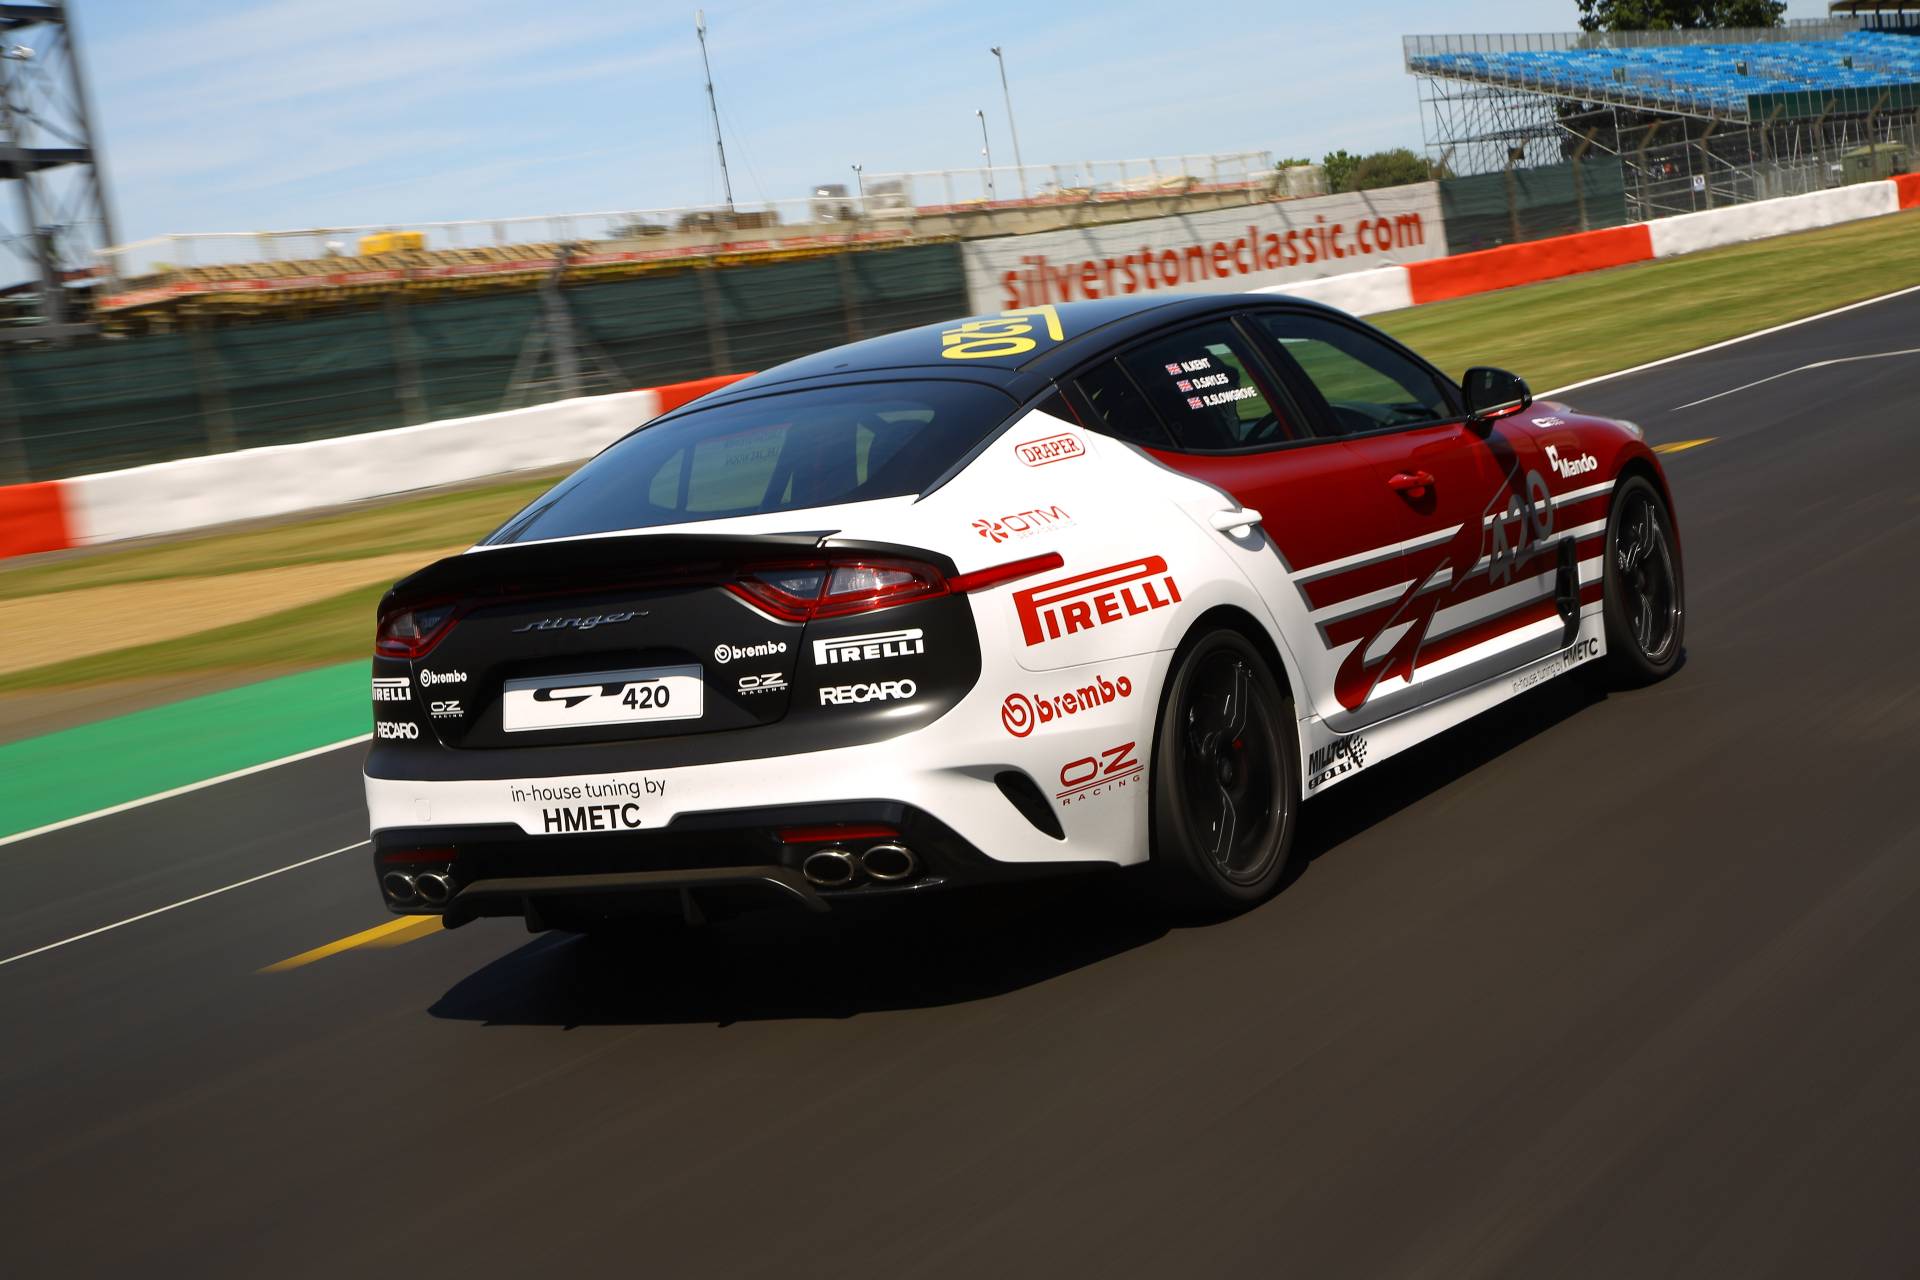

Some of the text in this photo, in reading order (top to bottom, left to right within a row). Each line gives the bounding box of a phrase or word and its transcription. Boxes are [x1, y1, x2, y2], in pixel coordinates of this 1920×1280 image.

[1003, 211, 1424, 310] silverstoneclassic.com
[1181, 358, 1211, 373] N.KENT
[1192, 373, 1229, 390] D.SAYLES
[1203, 386, 1258, 407] R.SLOWGROVE
[1021, 438, 1080, 463] DRAPER
[1558, 452, 1598, 478] Mando
[1000, 505, 1070, 532] OTM
[1489, 469, 1553, 586] 420
[1012, 555, 1182, 647] PIRELLI
[732, 640, 787, 660] brembo
[812, 628, 924, 665] PIRELLI
[1562, 638, 1599, 668] HMETC
[431, 669, 467, 684] brembo
[622, 685, 670, 710] 420
[819, 679, 917, 706] RECARO
[1034, 675, 1132, 724] brembo
[376, 721, 419, 739] RECARO
[1310, 761, 1351, 789] SPORT
[510, 777, 666, 803] in-house tuning by
[1062, 775, 1141, 806] RACING
[542, 802, 642, 833] HMETC
